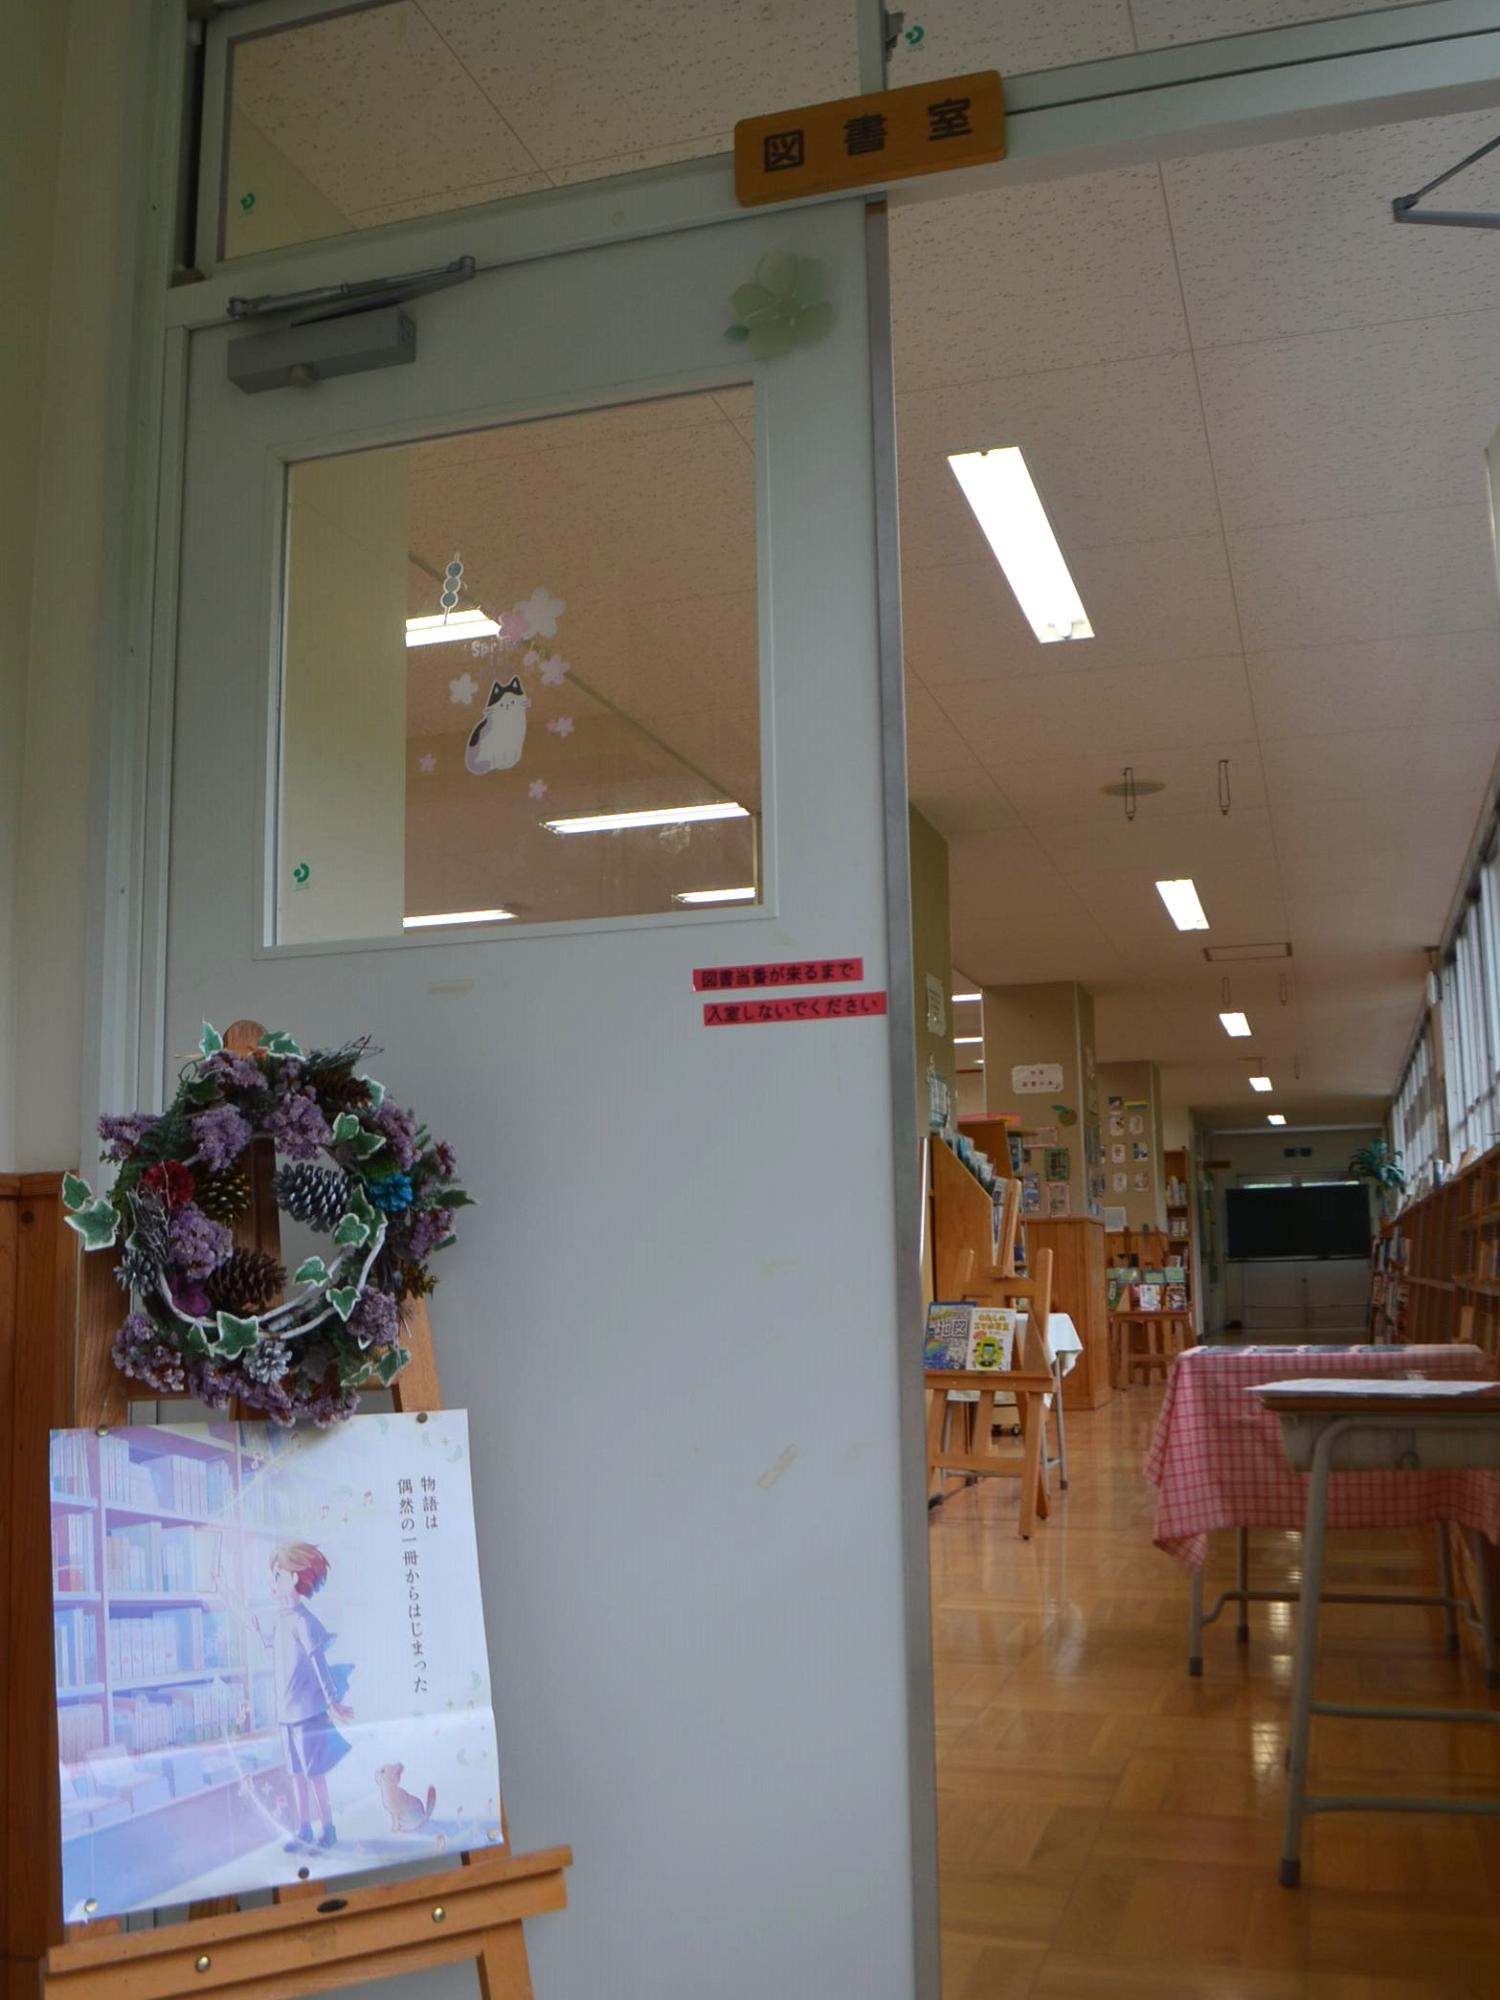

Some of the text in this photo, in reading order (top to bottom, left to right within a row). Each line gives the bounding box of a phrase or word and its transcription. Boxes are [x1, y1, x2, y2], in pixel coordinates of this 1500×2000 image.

[763, 97, 974, 173] 図書室
[701, 963, 854, 988] 図書当番が来るまで
[707, 998, 878, 1023] 入室しないでください
[420, 1475, 439, 1530] 物語は
[397, 1478, 428, 1692] 偶然の一冊からはじまった
